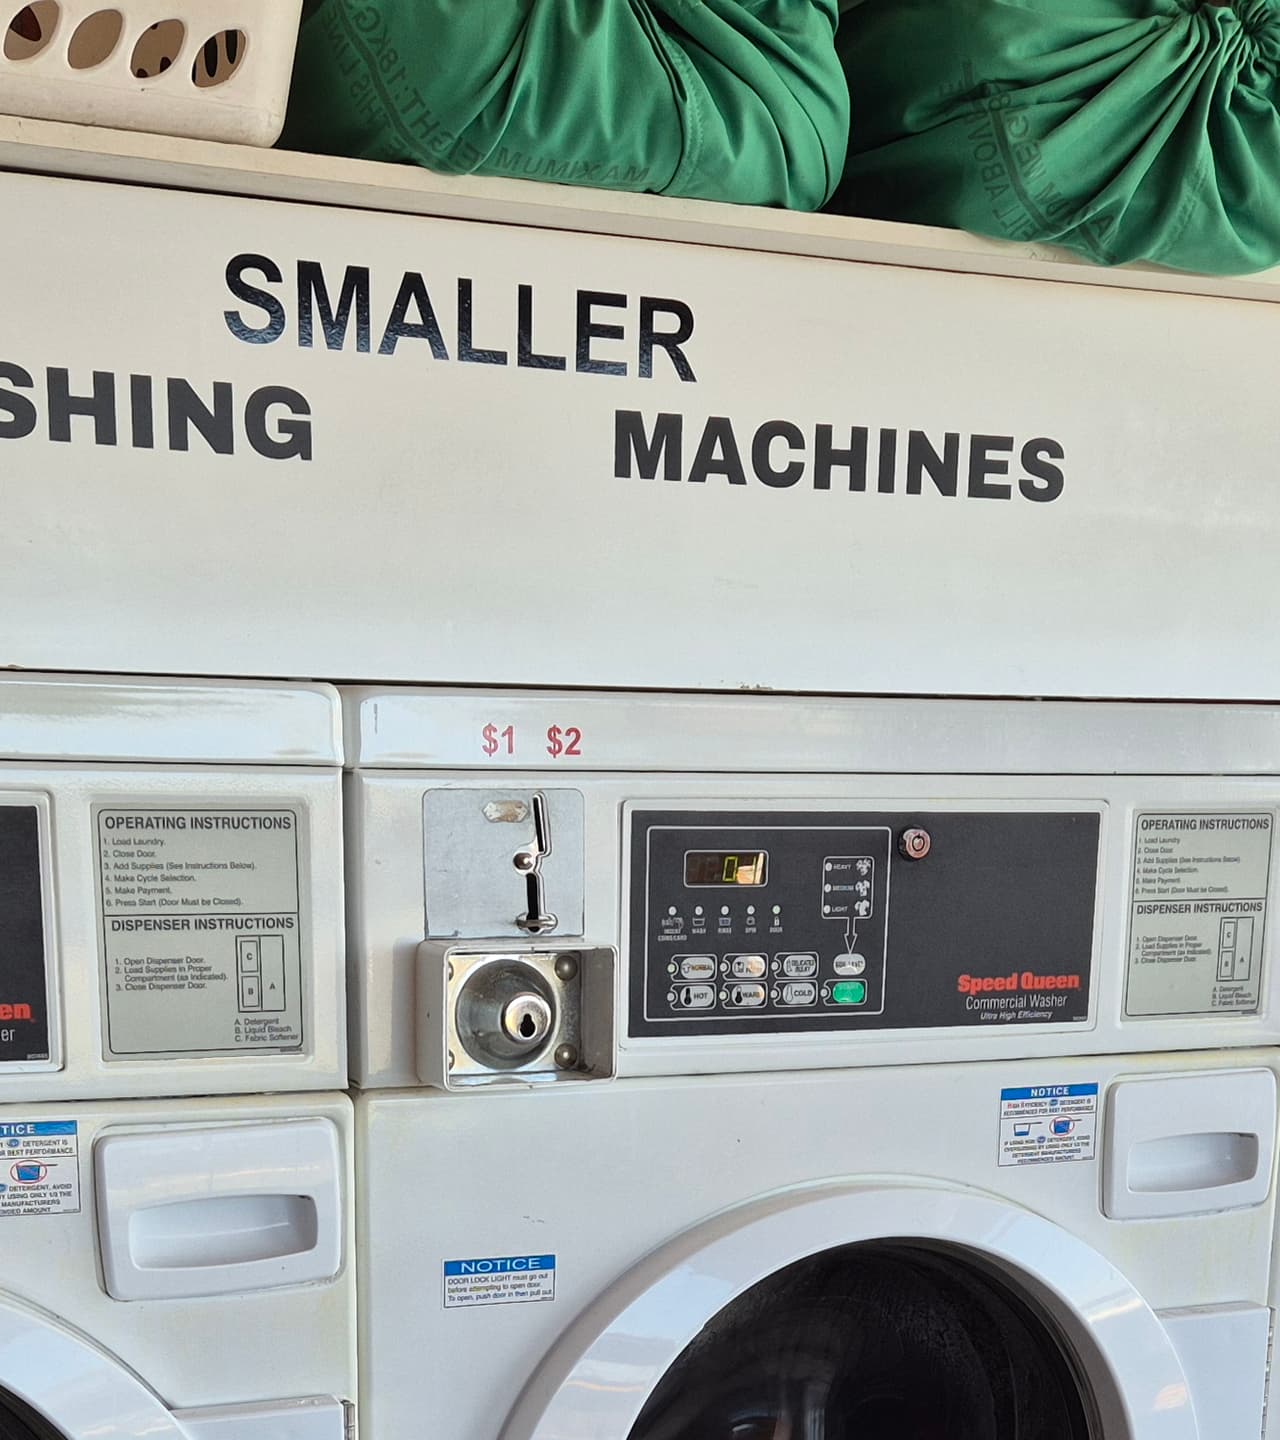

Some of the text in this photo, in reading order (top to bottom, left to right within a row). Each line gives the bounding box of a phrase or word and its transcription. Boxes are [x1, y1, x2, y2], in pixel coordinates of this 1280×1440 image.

[223, 252, 697, 383] SMALLER
[615, 410, 1064, 502] MACHINES
[482, 723, 581, 758] $1 $2
[105, 816, 291, 830] OPERATING INSTRUCTIONS
[1141, 818, 1269, 830] OPERATING INSTRUCTIONS
[113, 850, 134, 858] Close
[131, 863, 164, 871] Supplies
[167, 862, 183, 871] (See
[185, 862, 228, 870] Instructions
[137, 875, 158, 883] Cycle
[1136, 902, 1263, 914] DISPENSER INSTRUCTIONS
[112, 918, 294, 932] DISPENSER INSTRUCTIONS
[124, 958, 144, 966] Open
[147, 957, 183, 965] Dispenser
[146, 966, 177, 974] Supplies
[188, 965, 212, 973] Proper
[125, 975, 175, 983] Compartment
[958, 971, 1079, 995] Speed Queen
[125, 983, 146, 991] Close
[149, 983, 185, 991] Dispenser
[966, 994, 1067, 1010] Commercial Washer
[980, 1012, 997, 1020] Ultra
[999, 1012, 1016, 1020] High
[244, 1018, 279, 1027] Detergent
[245, 1026, 266, 1034] Liquid
[1031, 1087, 1070, 1097] NOTICE
[25, 1147, 73, 1156] PERFORMANCE
[461, 1258, 540, 1273] NOTICE
[469, 1284, 501, 1292] attempting
